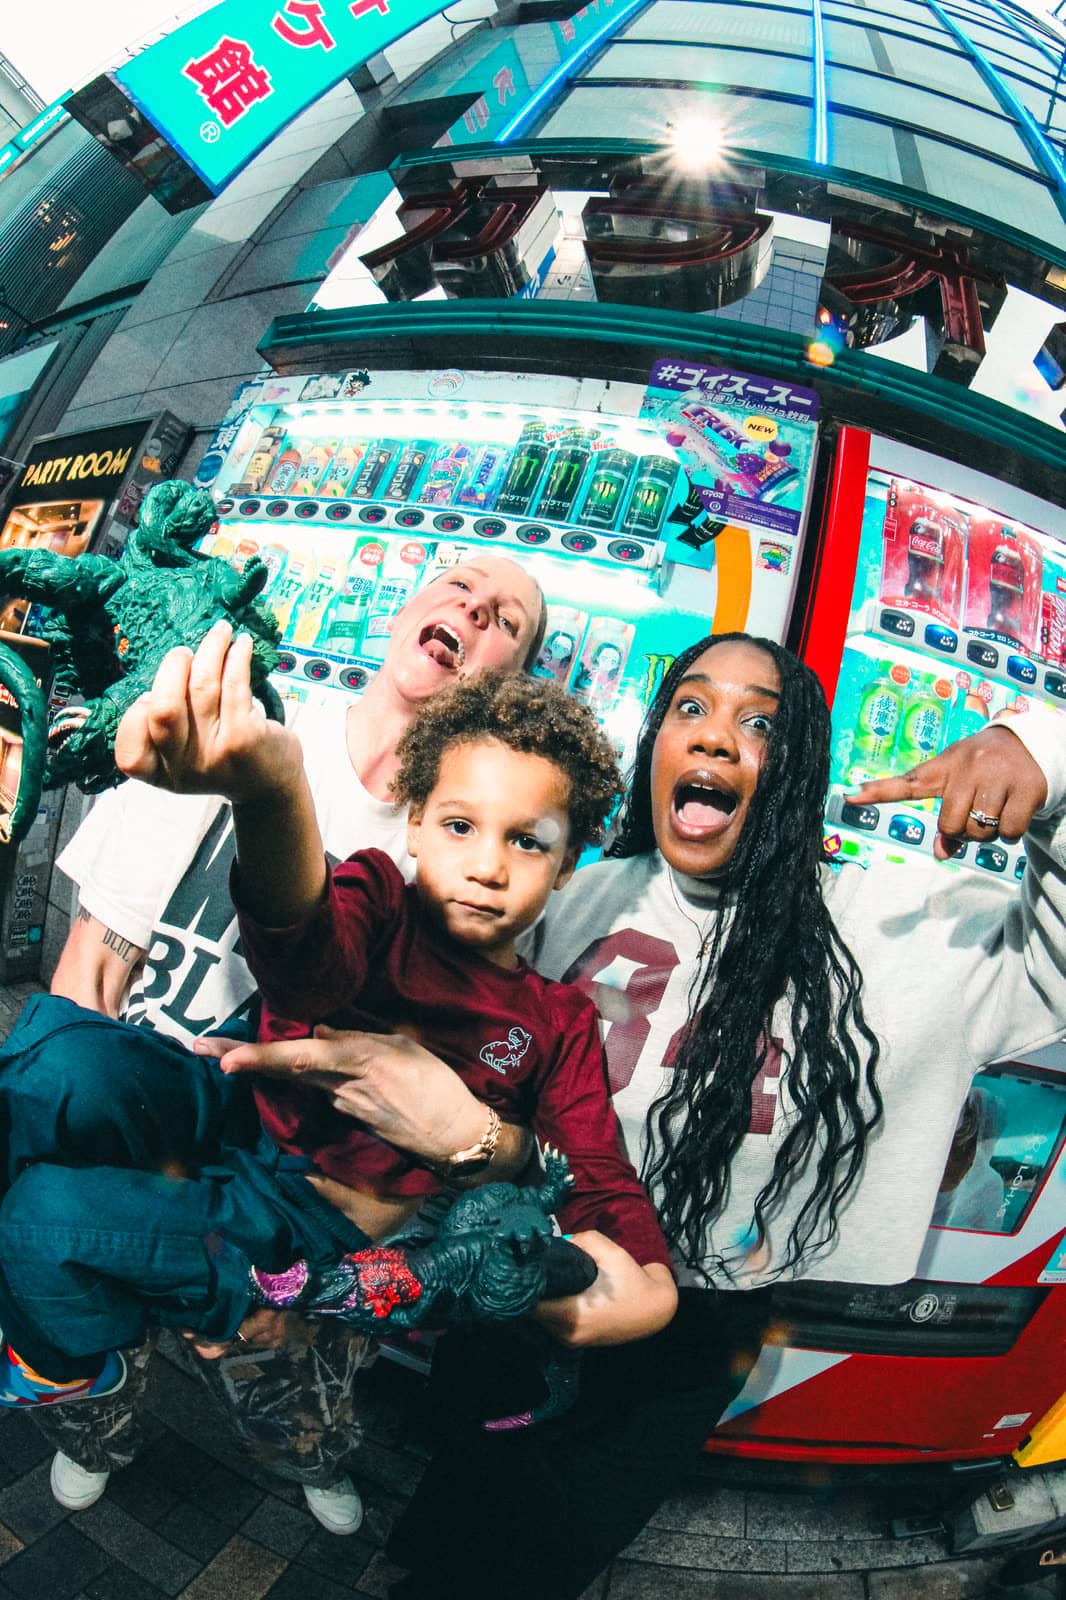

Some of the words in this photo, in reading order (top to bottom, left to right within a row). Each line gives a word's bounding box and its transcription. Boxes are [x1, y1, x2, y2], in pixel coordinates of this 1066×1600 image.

[181, 0, 390, 130] ケ館
[748, 423, 774, 434] NEW
[21, 456, 73, 488] PARTY
[66, 446, 133, 481] ROOM
